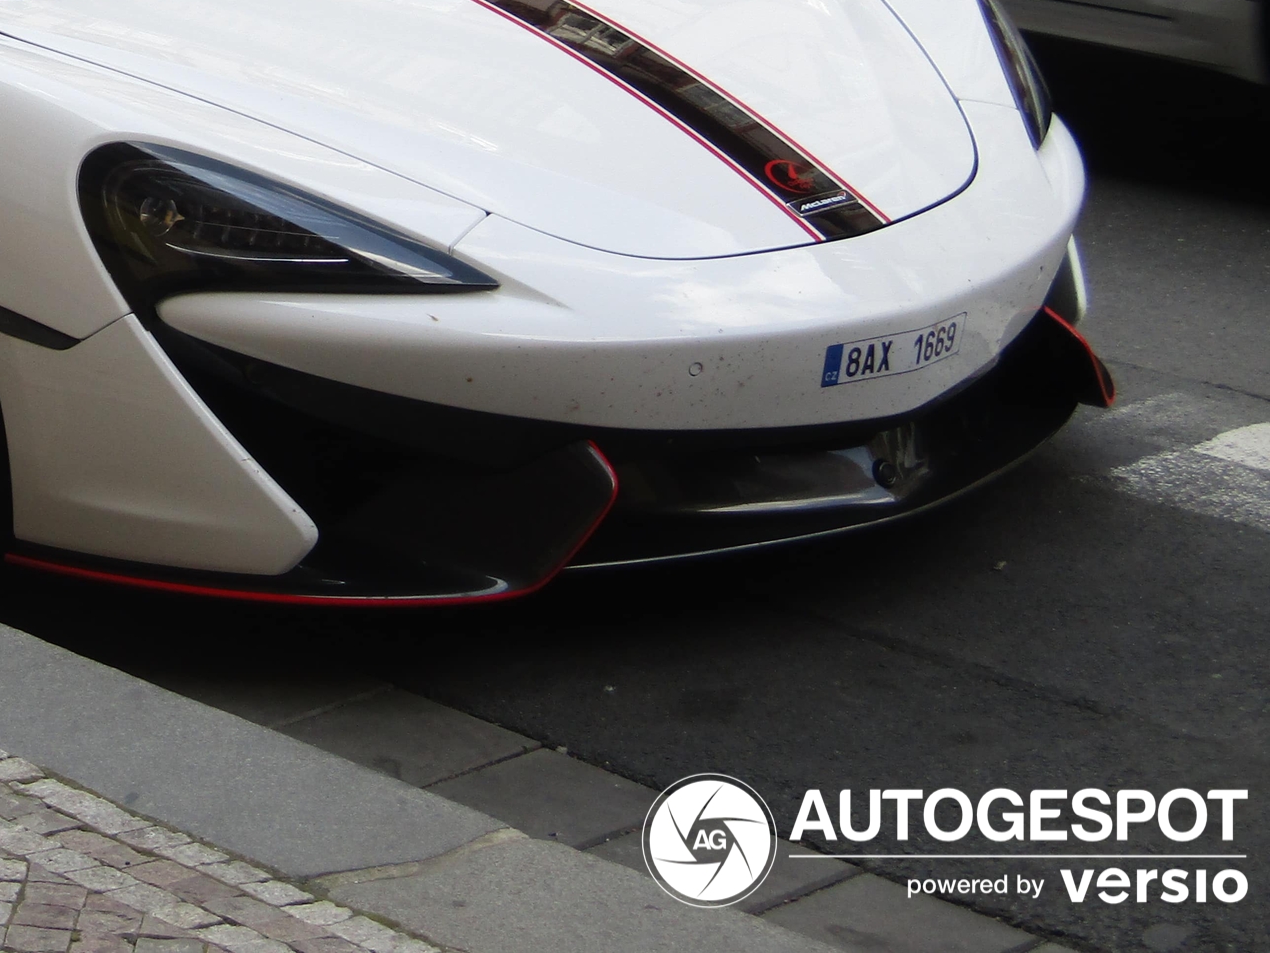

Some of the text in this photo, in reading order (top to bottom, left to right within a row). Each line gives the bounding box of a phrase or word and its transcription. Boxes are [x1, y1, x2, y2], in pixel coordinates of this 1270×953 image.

[800, 195, 847, 211] McLaren
[824, 321, 957, 381] CZ 8AX 1669
